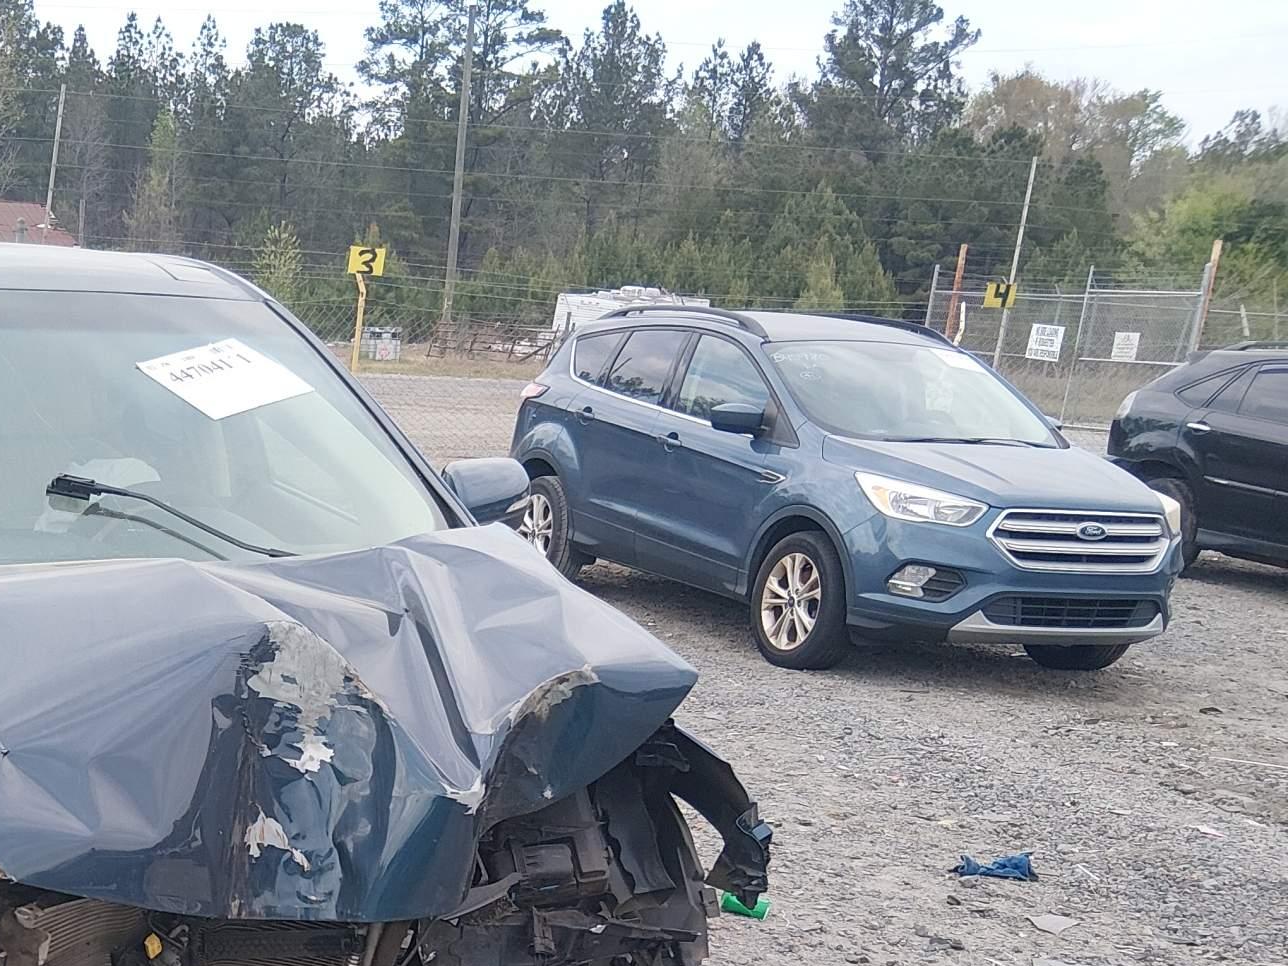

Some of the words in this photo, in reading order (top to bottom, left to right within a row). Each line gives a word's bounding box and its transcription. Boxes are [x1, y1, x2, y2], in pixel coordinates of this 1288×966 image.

[356, 248, 378, 275] 3
[994, 284, 1012, 308] 4
[169, 353, 252, 383] 4470411
[1084, 526, 1102, 536] Ford
